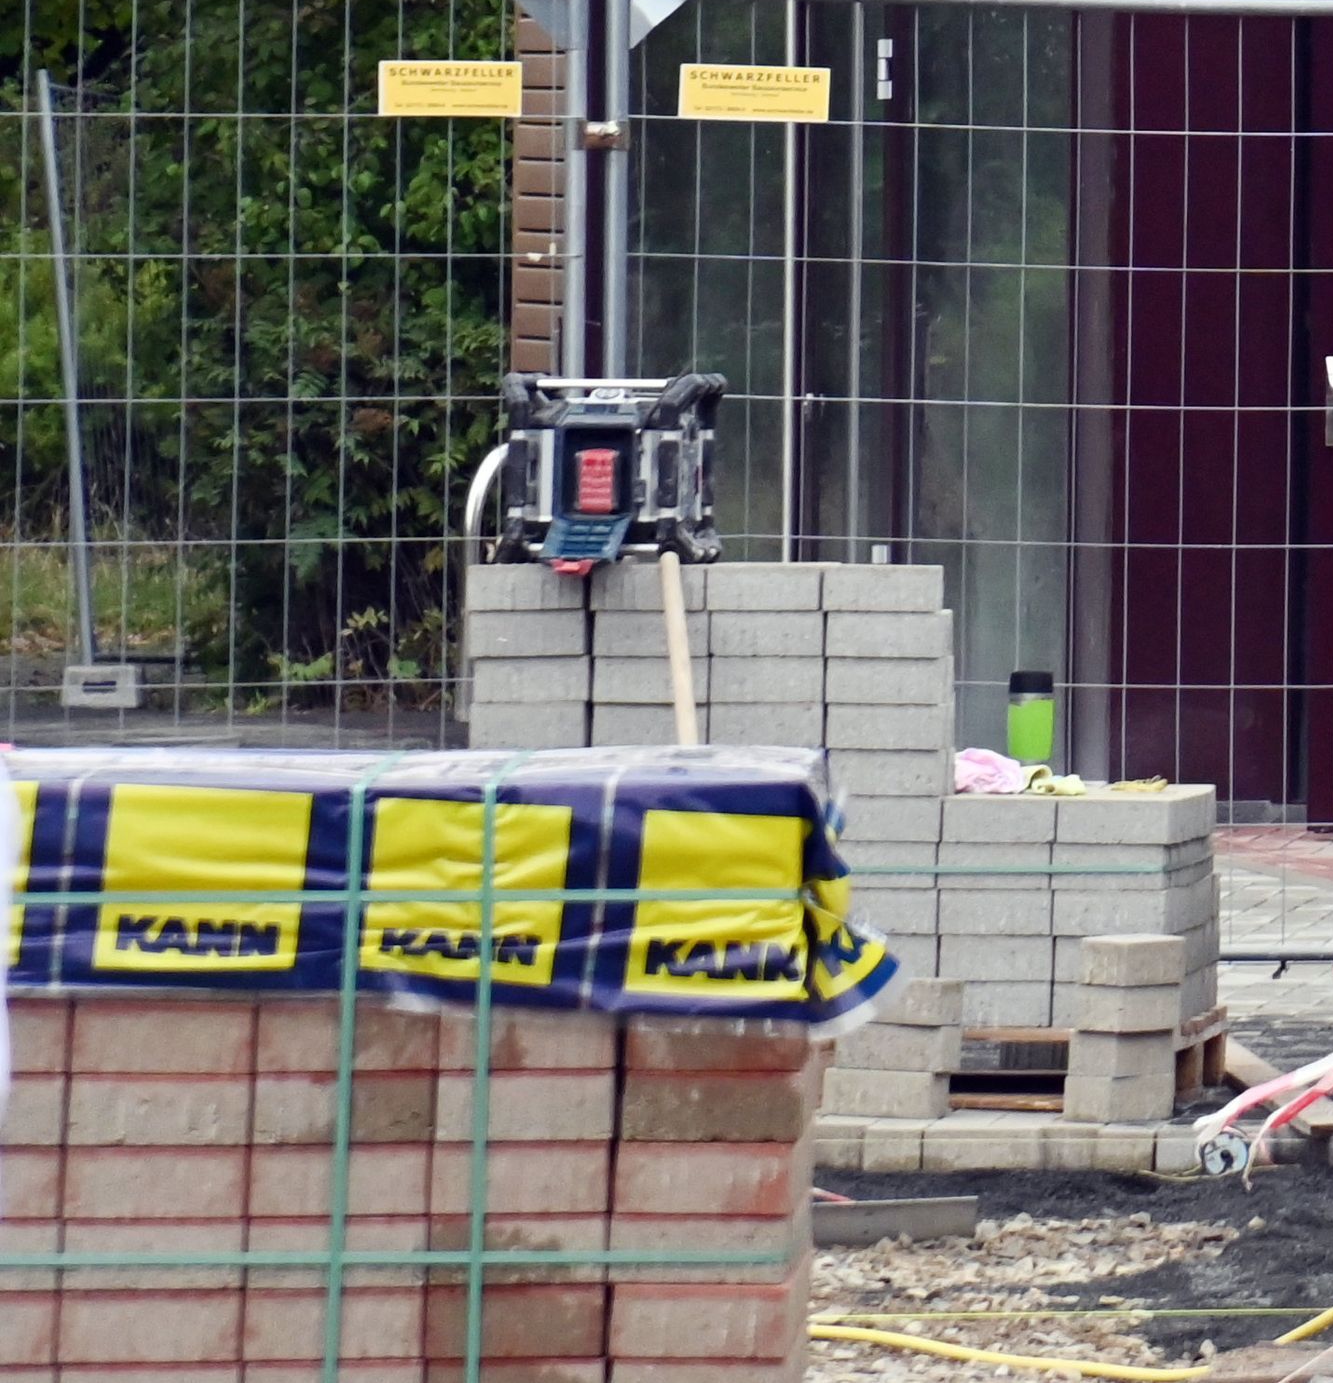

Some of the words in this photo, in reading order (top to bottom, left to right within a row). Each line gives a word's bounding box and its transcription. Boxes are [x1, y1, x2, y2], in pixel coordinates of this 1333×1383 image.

[389, 67, 513, 78] SCHWARZFELLER
[690, 70, 821, 83] SCHWARZFELLER
[116, 913, 280, 958] KANN
[379, 927, 542, 966] KANN
